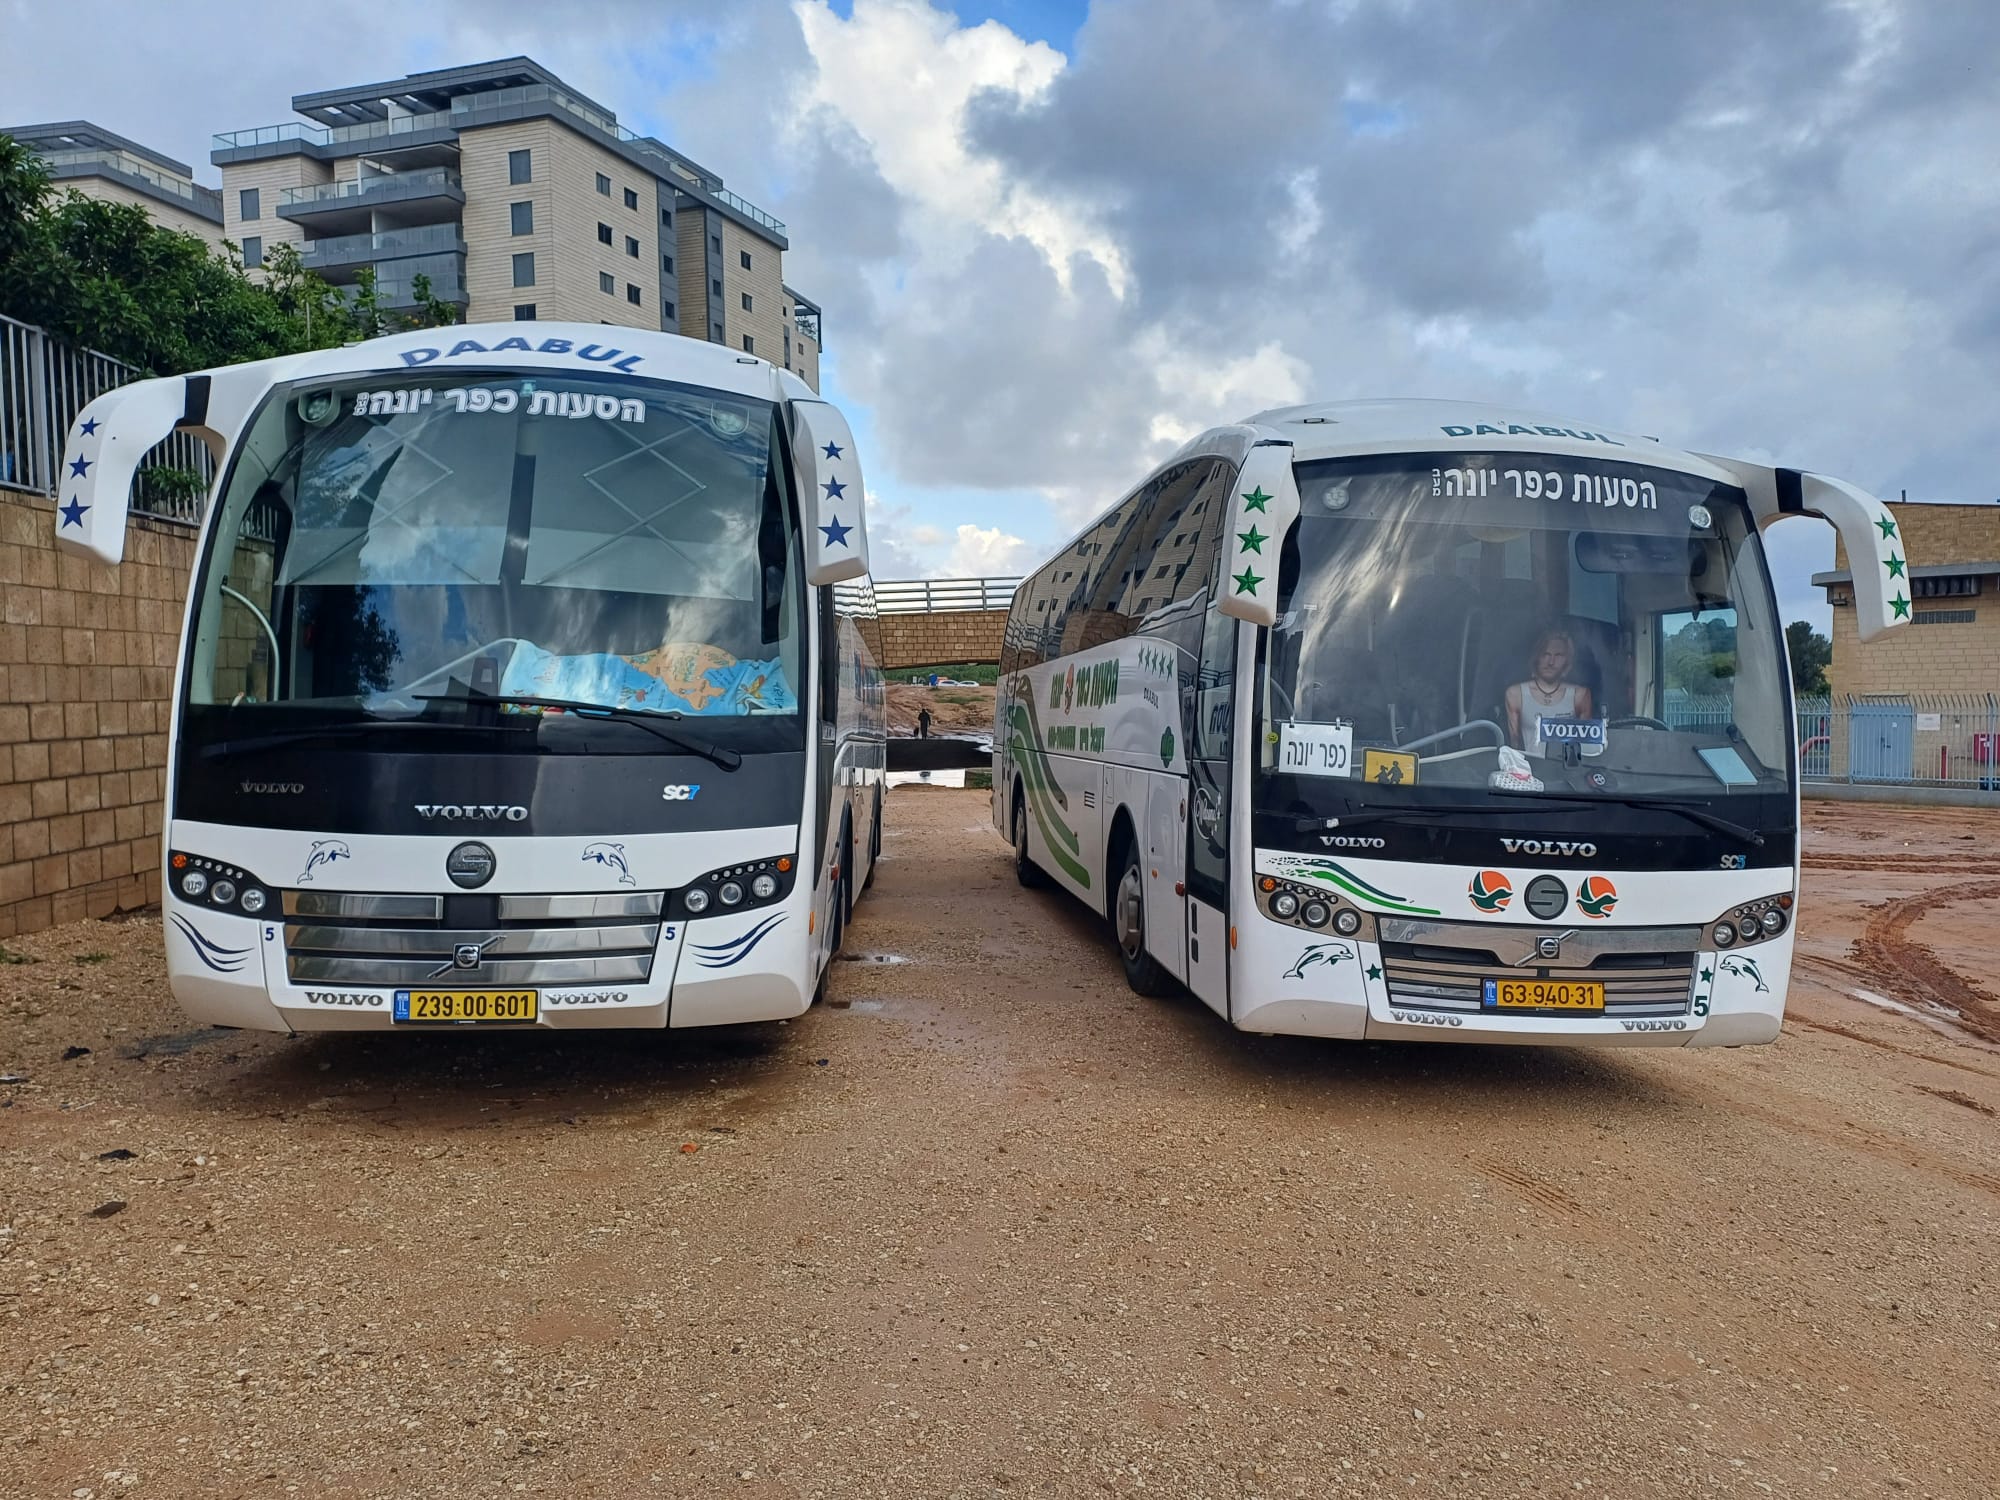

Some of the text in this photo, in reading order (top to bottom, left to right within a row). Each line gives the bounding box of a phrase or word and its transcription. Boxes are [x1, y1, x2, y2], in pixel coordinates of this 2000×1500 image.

[399, 337, 645, 373] DAABUL
[369, 388, 646, 423] הסעות כפר יונה
[1440, 424, 1626, 447] DAABUL
[1444, 469, 1657, 510] הסעות כפר יונה
[1542, 723, 1601, 739] VOLVO
[1287, 741, 1347, 769] כפר יונה
[240, 782, 305, 794] VOLVO
[662, 784, 701, 801] SC7
[414, 805, 529, 822] VOLVO
[1320, 836, 1386, 849] VOLVO
[1500, 838, 1598, 858] VOLVO
[1720, 854, 1747, 869] SC5
[265, 927, 275, 942] 5
[665, 927, 676, 941] 5
[304, 991, 384, 1006] VOLVO
[546, 992, 629, 1005] VOLVO
[1694, 995, 1710, 1017] 5
[1390, 1011, 1463, 1027] VOLVO
[1620, 1020, 1687, 1031] VOLVO
